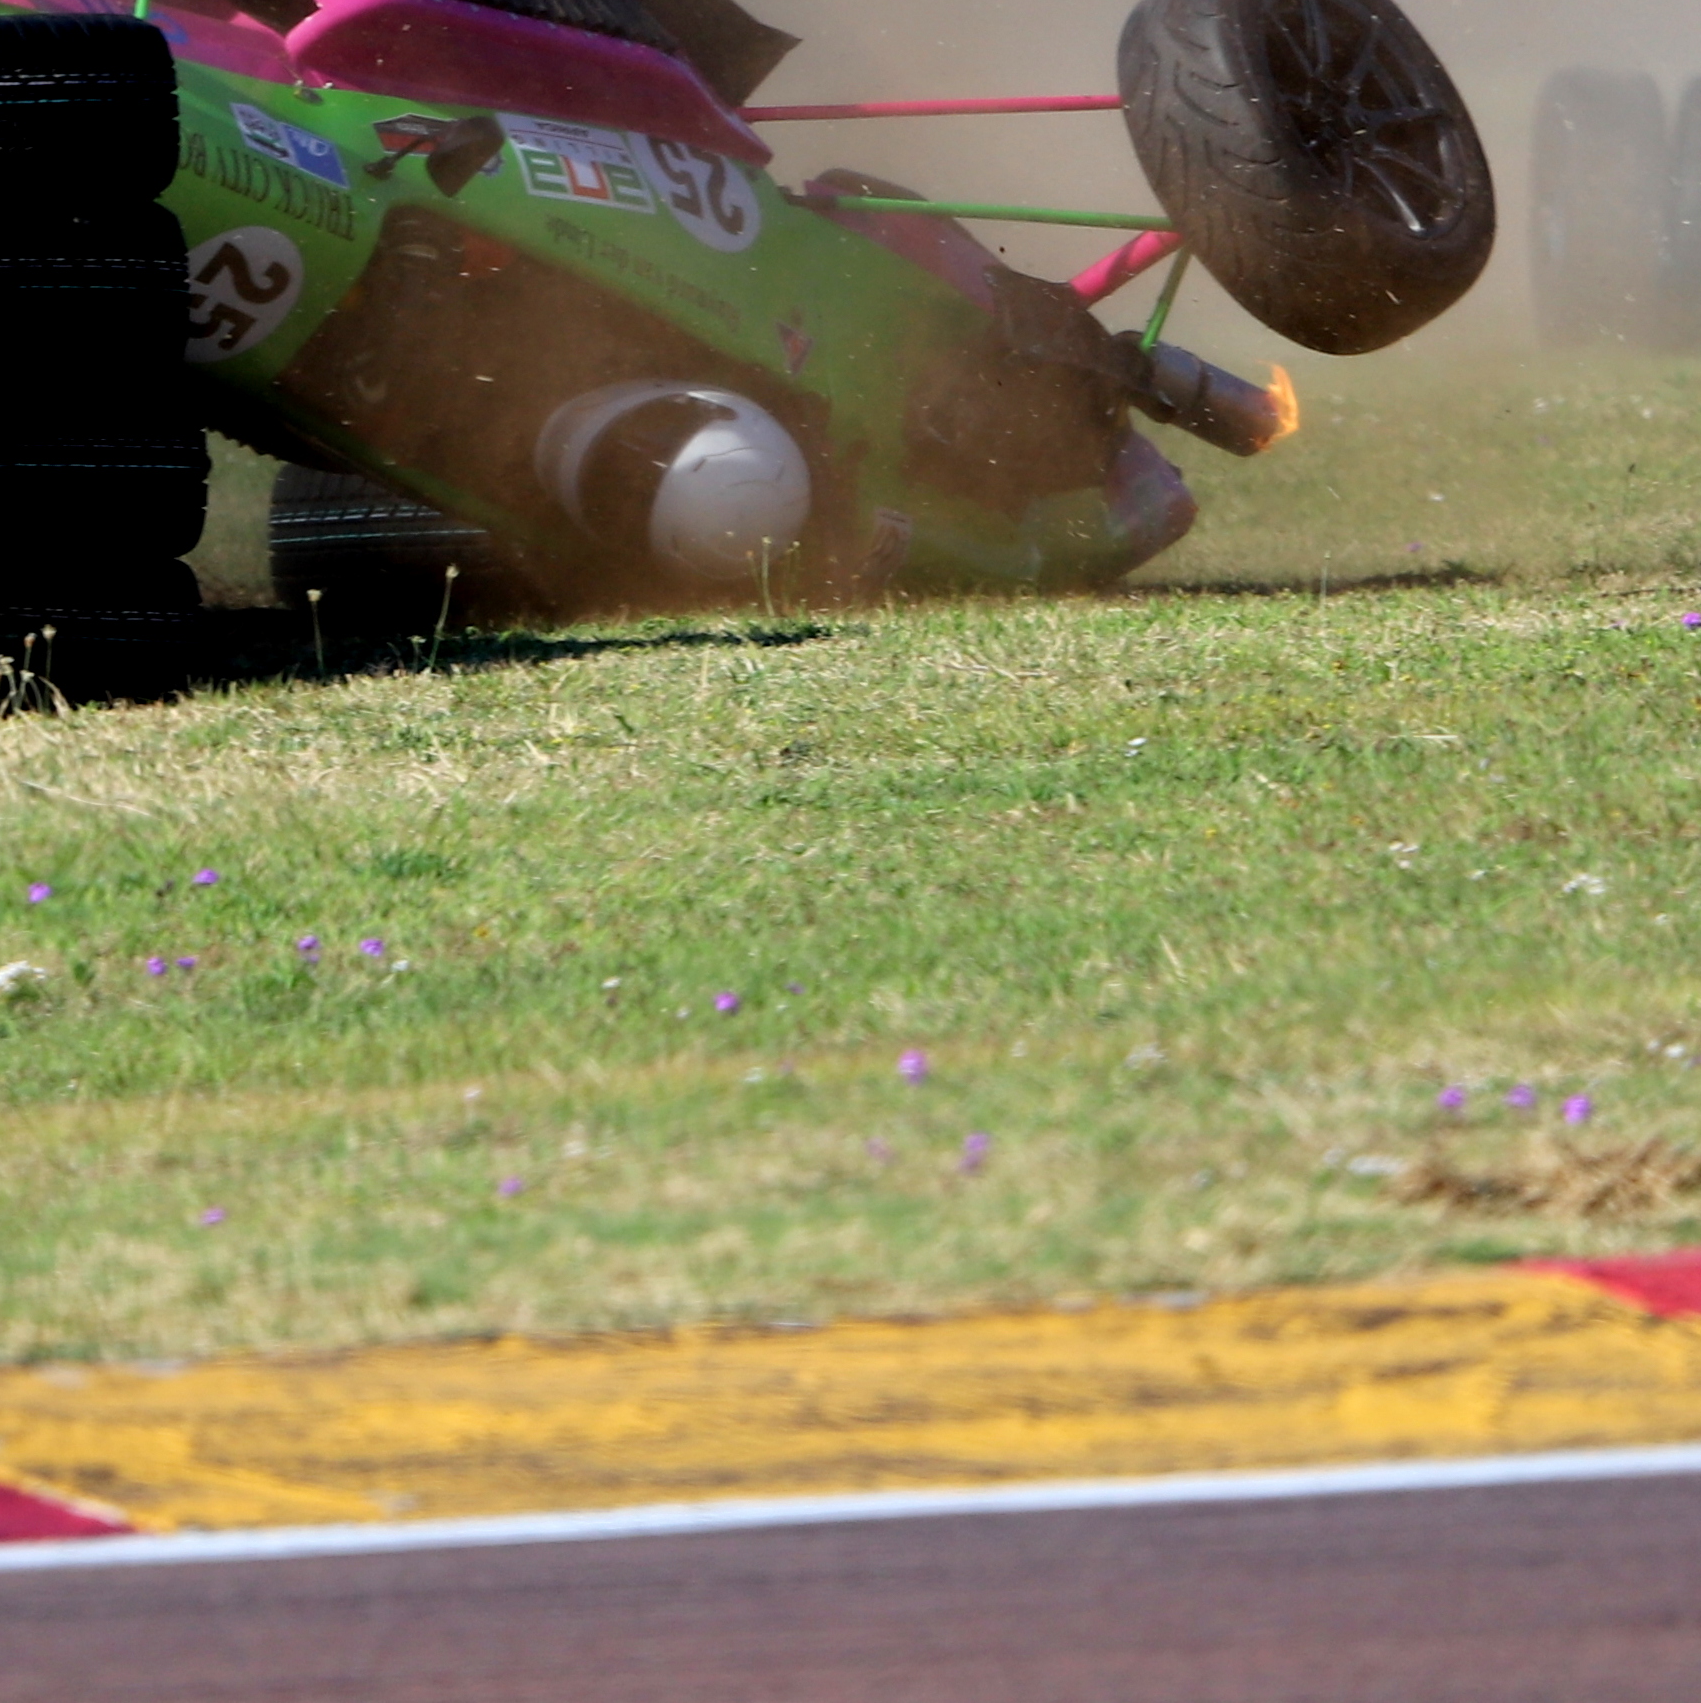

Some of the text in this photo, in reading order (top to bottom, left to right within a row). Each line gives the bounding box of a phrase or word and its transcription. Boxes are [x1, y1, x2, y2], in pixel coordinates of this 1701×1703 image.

[216, 144, 271, 203] CITY
[274, 164, 355, 241] TRUCK
[646, 135, 745, 235] 25
[188, 241, 291, 351] 25
